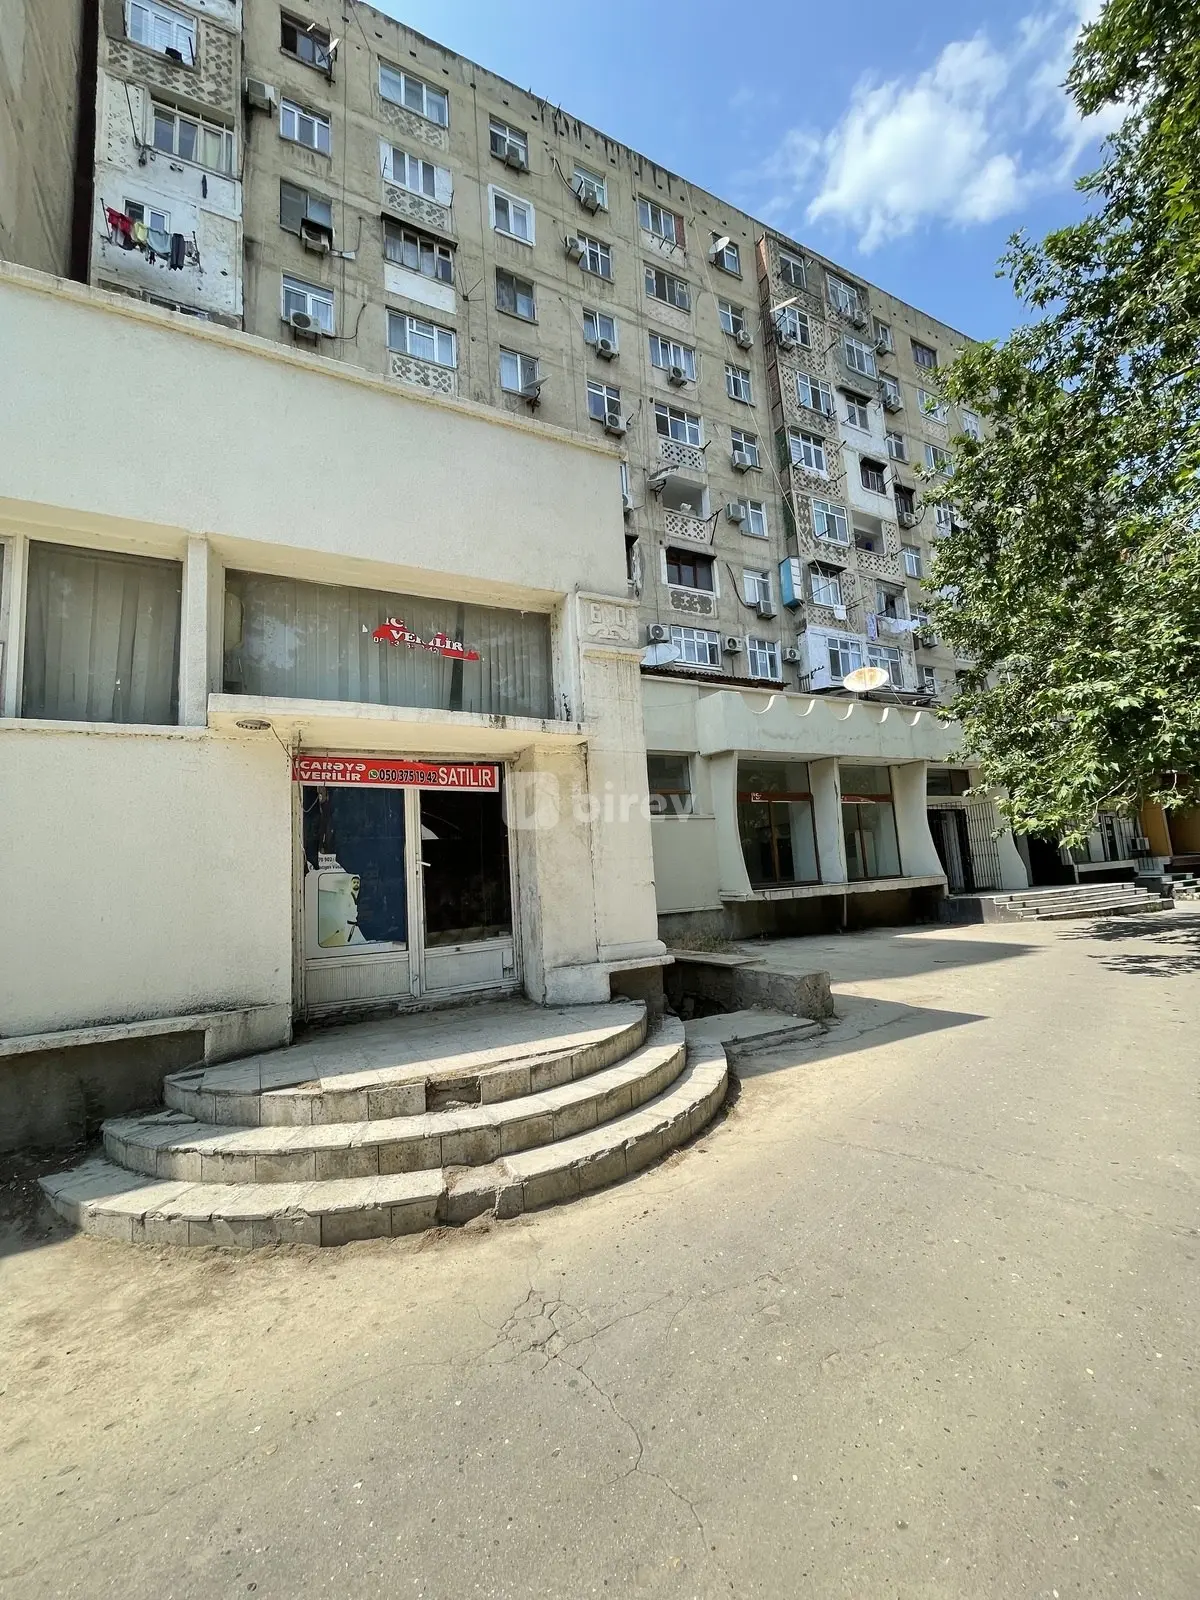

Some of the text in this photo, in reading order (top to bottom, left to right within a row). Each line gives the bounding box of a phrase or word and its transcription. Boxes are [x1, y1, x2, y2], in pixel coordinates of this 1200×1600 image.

[300, 770, 361, 781] VERİLİR
[379, 769, 437, 784] 050 375 19 42
[438, 767, 492, 787] SATILIR
